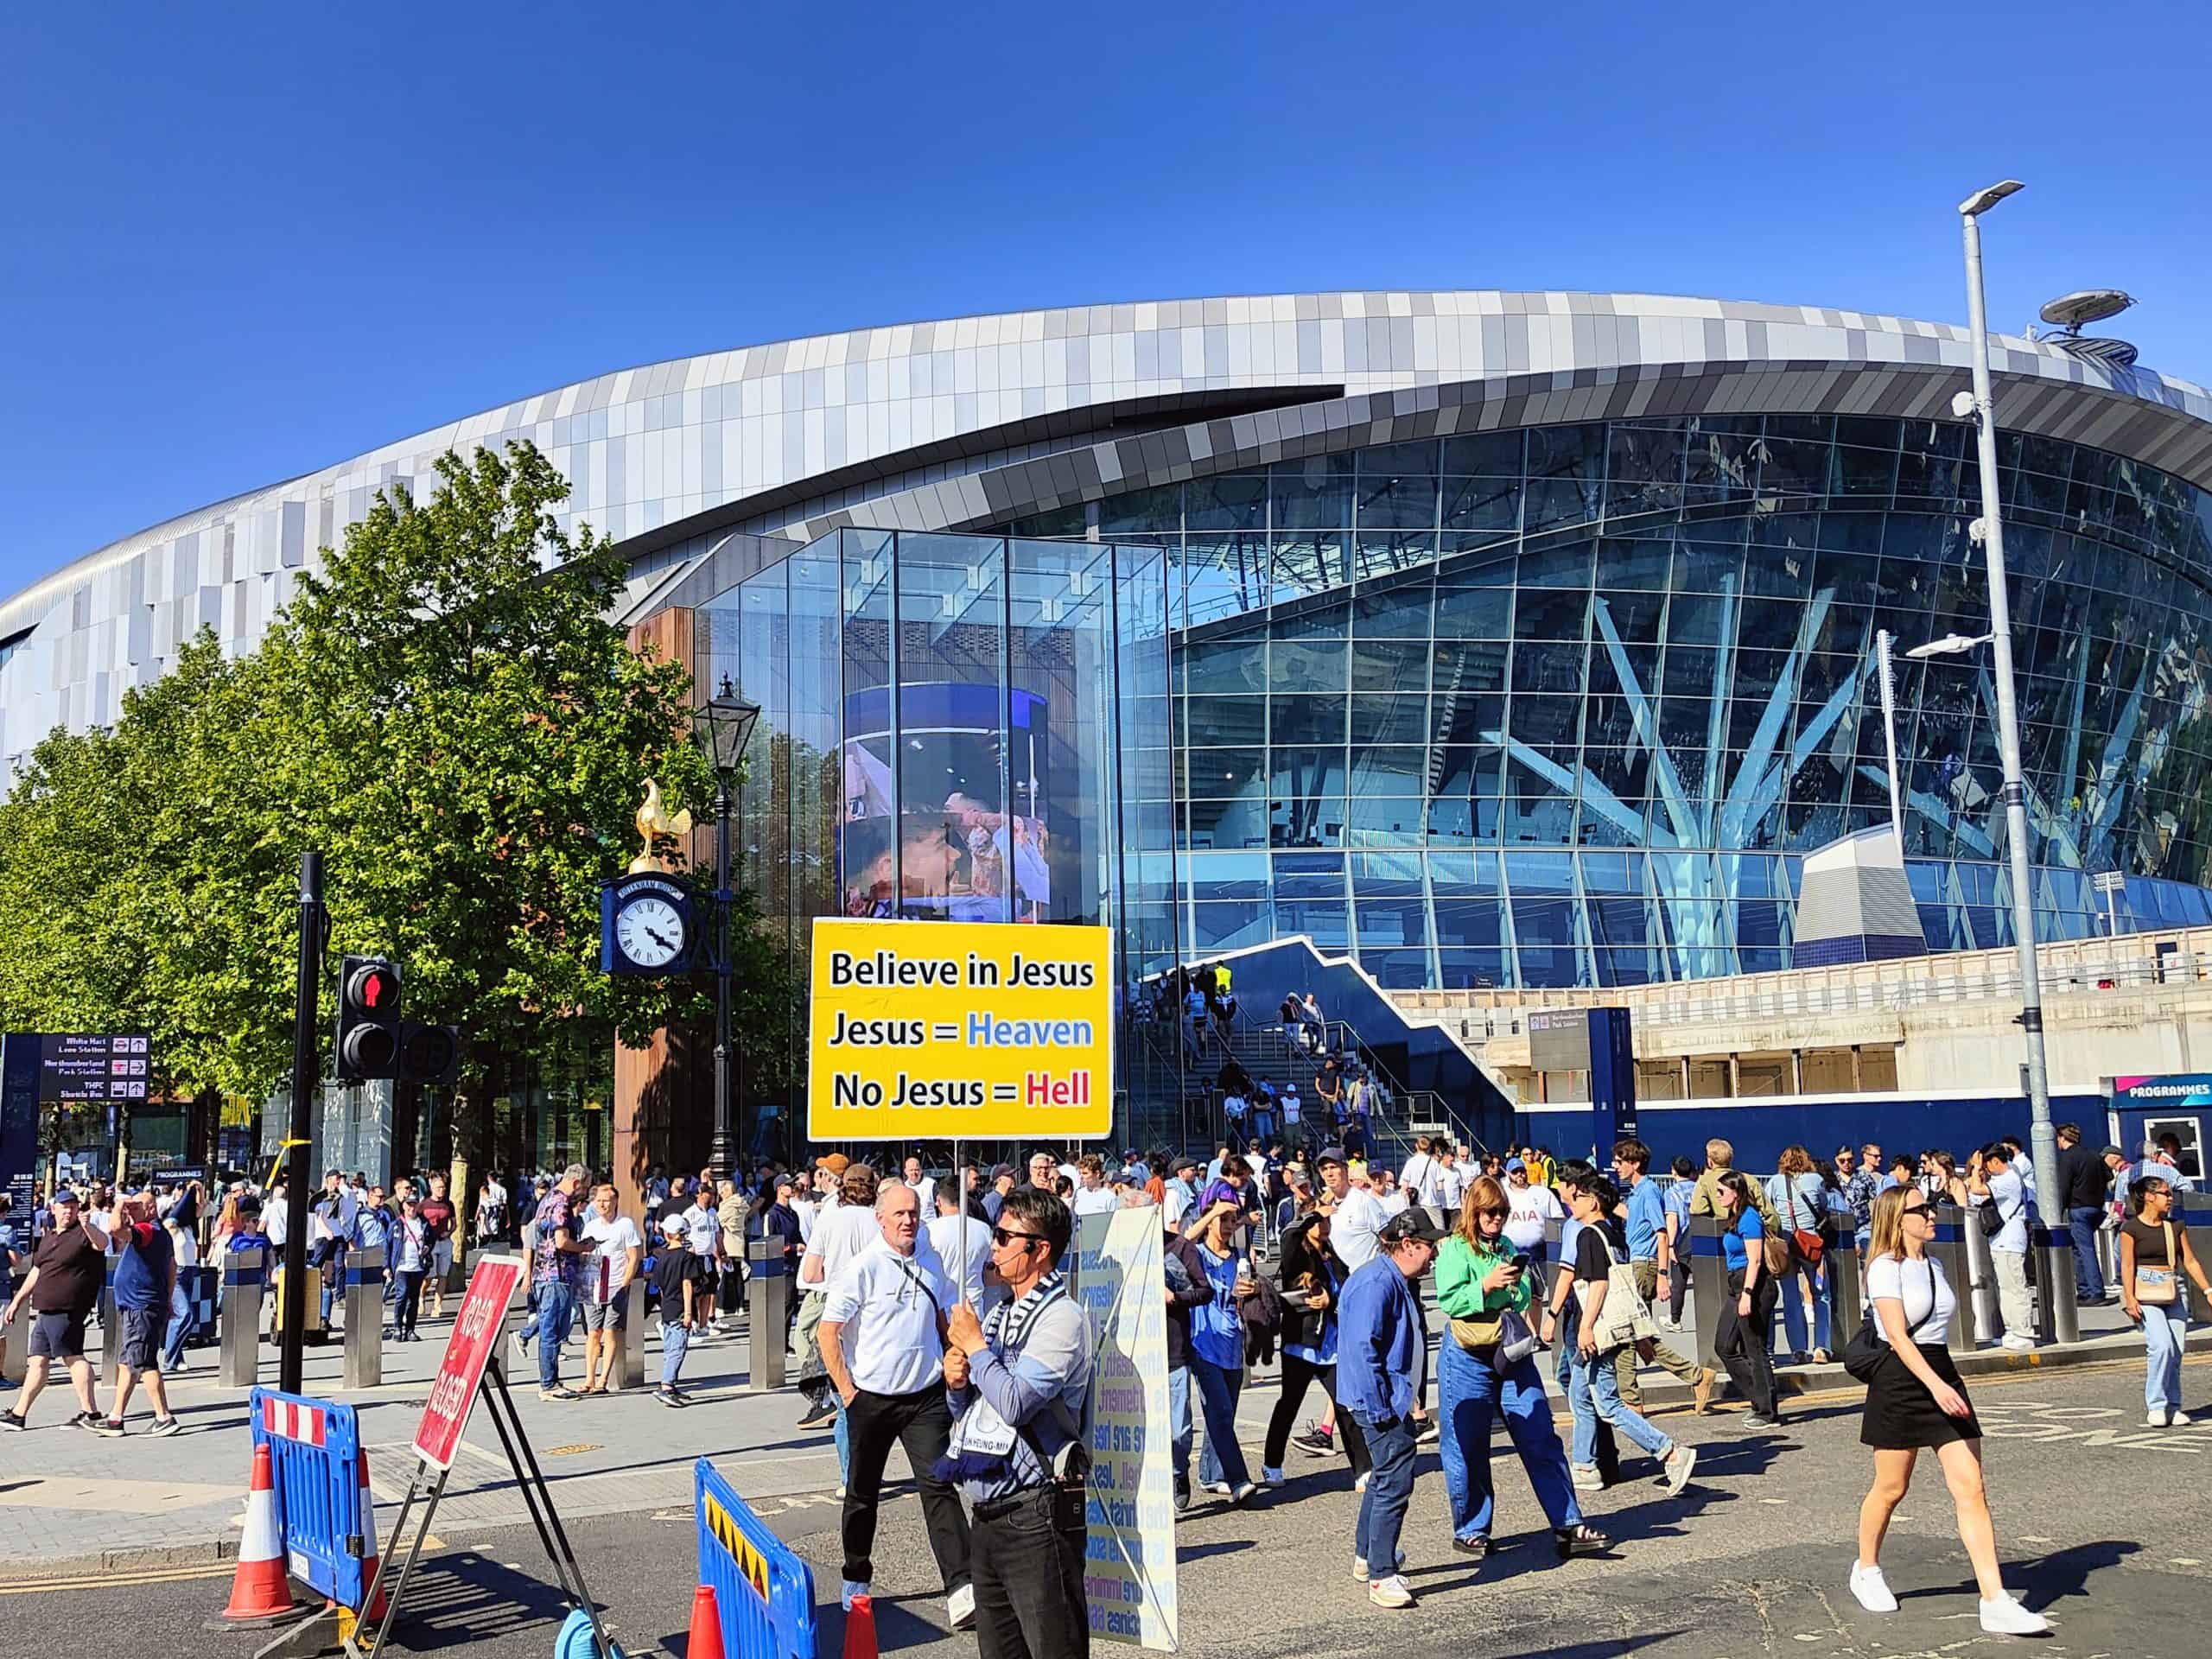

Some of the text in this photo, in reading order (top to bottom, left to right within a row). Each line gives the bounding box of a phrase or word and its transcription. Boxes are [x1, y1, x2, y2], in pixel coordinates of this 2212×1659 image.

[831, 951, 1094, 987] Believe in Jesus
[830, 1013, 1092, 1046] Jesus = Heaven
[84, 1081, 105, 1090] THFC
[834, 1071, 1089, 1107] No Jesus = Hell
[2129, 1084, 2211, 1098] PROGRAMMES
[156, 1169, 202, 1179] PROGRAMMES
[1511, 1210, 1539, 1224] AIA
[461, 1294, 493, 1339] ROAD
